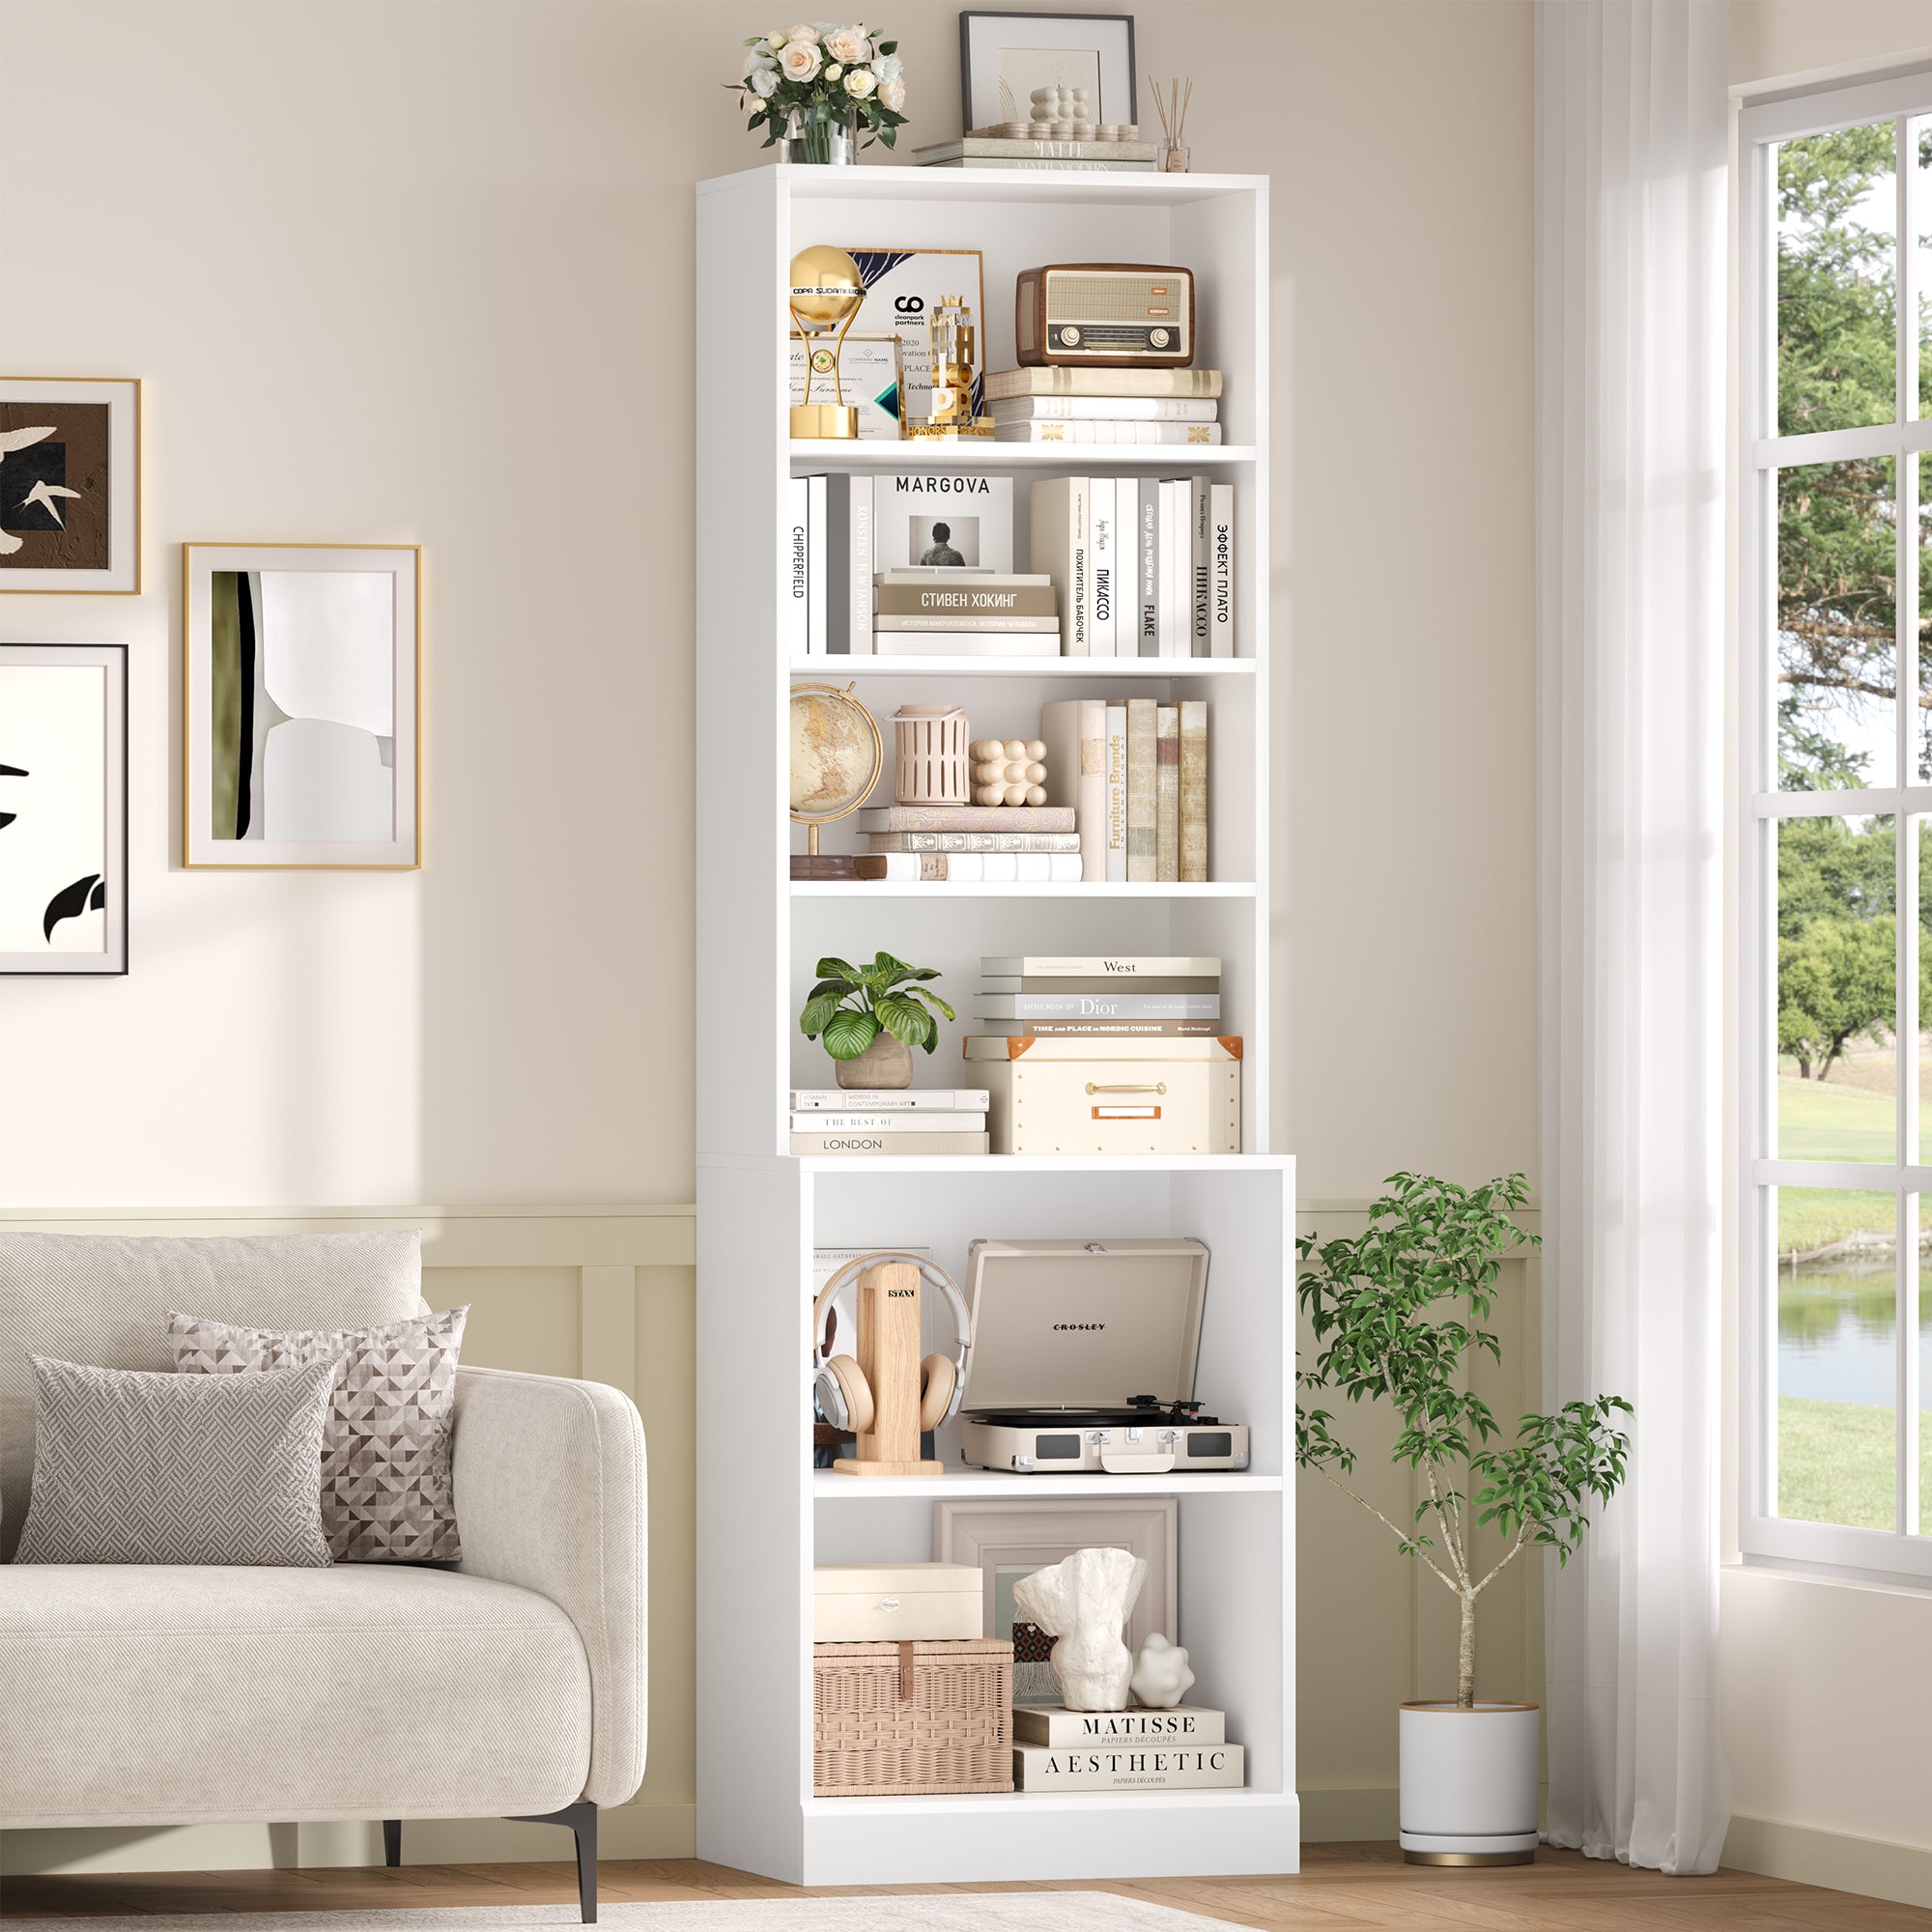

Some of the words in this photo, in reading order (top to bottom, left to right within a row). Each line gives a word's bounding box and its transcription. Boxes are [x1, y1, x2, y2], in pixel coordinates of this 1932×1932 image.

[1034, 142, 1084, 157] MATTE
[908, 426, 947, 436] HONORS
[896, 477, 990, 494] MARGOVA
[857, 505, 867, 556] KONSTEN
[1217, 525, 1229, 576] ЭФФЕКТ
[793, 526, 805, 598] CHIPPERFIELD
[921, 593, 968, 607] СТИВЕН
[972, 593, 1017, 608] ХОКИНГ
[1096, 569, 1109, 621] ПИКАССО
[1196, 566, 1208, 638] ПИКАССО
[1217, 580, 1229, 623] ПЛАТО
[1144, 605, 1155, 637] FLAKE
[1109, 734, 1120, 784] Brands
[1109, 787, 1120, 850] Furniture
[1103, 961, 1137, 973] West
[1080, 998, 1119, 1015] Dior
[825, 1118, 846, 1126] THE
[850, 1118, 875, 1126] BEST
[880, 1118, 894, 1126] OF
[823, 1139, 882, 1150] LONDON
[1082, 1716, 1196, 1735] MATISSE
[1135, 1735, 1177, 1744] DÉCOUPÉS
[1044, 1752, 1226, 1774] AESTHETIC
